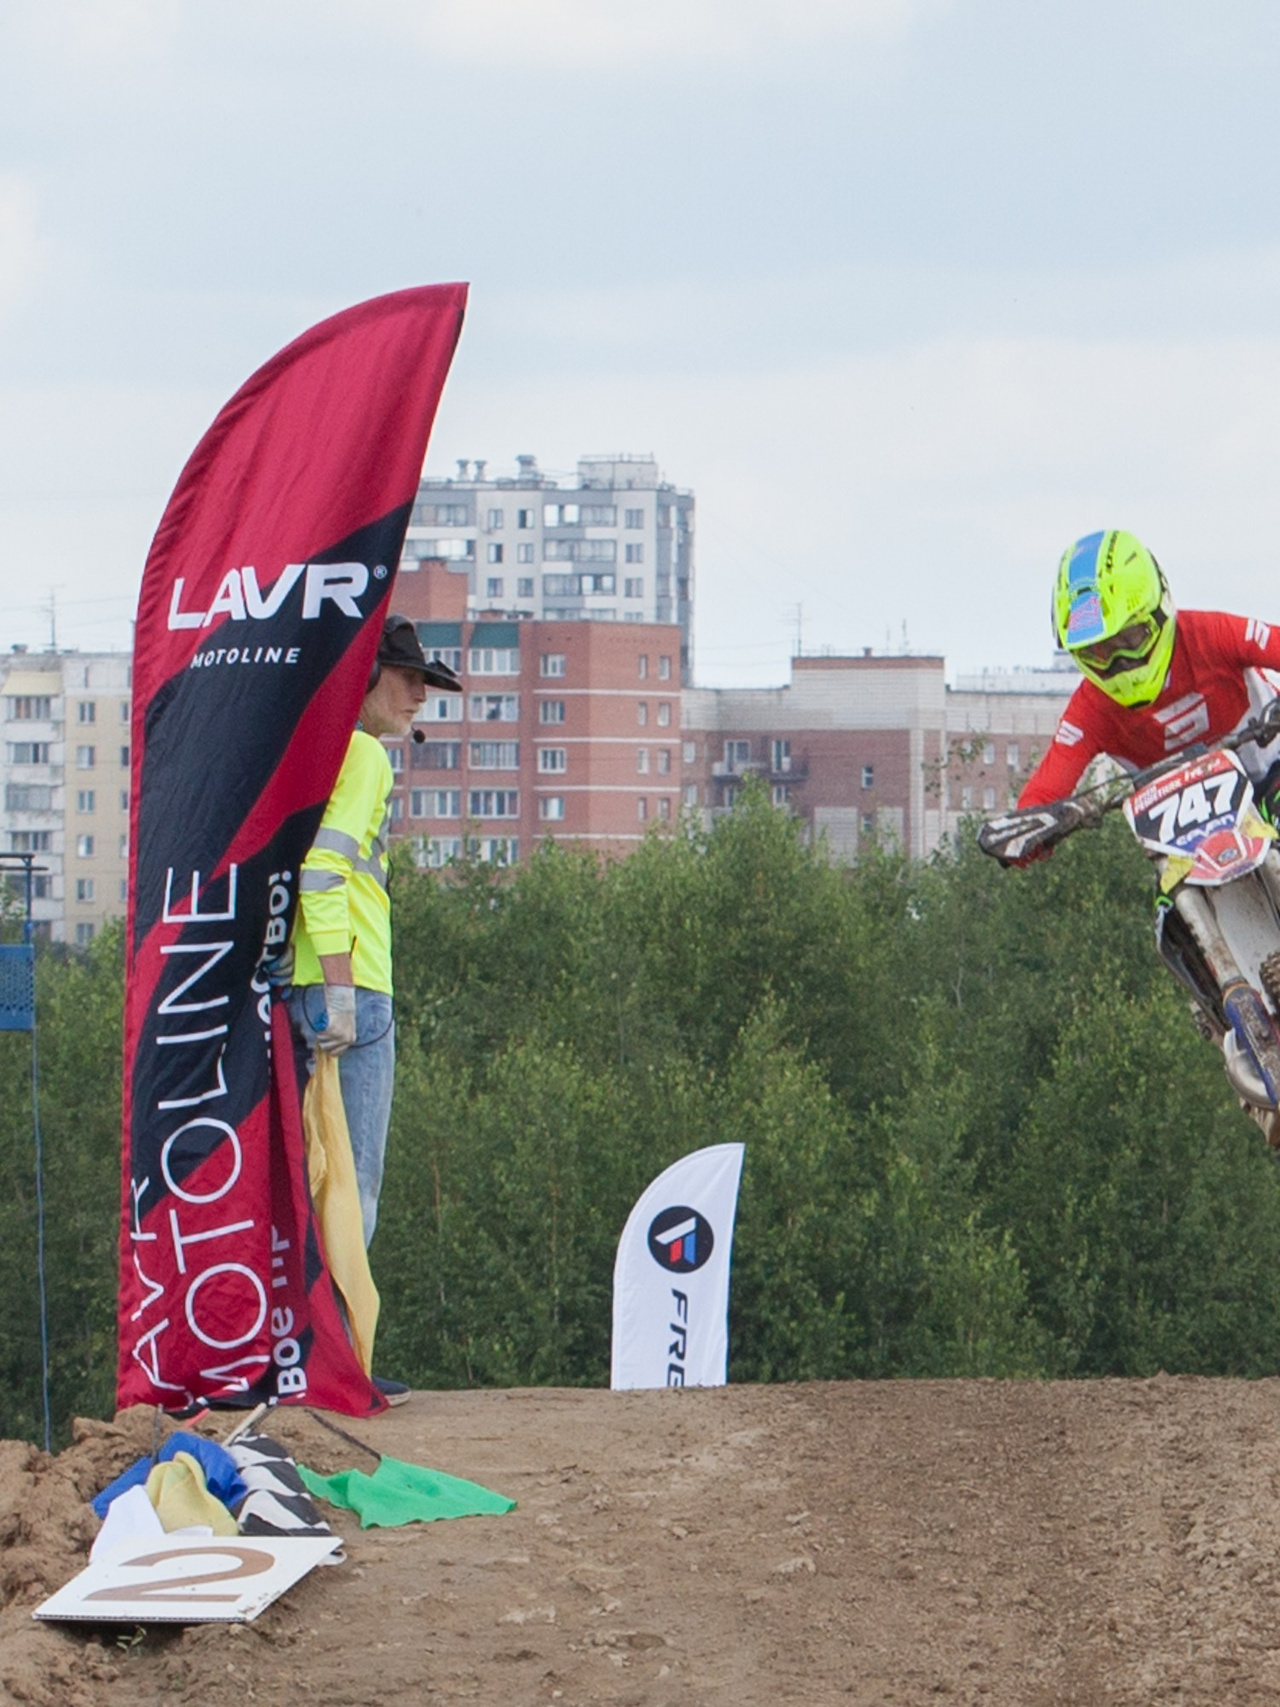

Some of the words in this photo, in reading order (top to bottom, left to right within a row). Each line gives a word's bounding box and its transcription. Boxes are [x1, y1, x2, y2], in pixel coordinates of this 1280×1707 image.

[168, 562, 369, 631] LAVR
[190, 647, 301, 669] MOTOLINE
[1148, 770, 1239, 844] 747
[82, 1546, 276, 1602] 2
